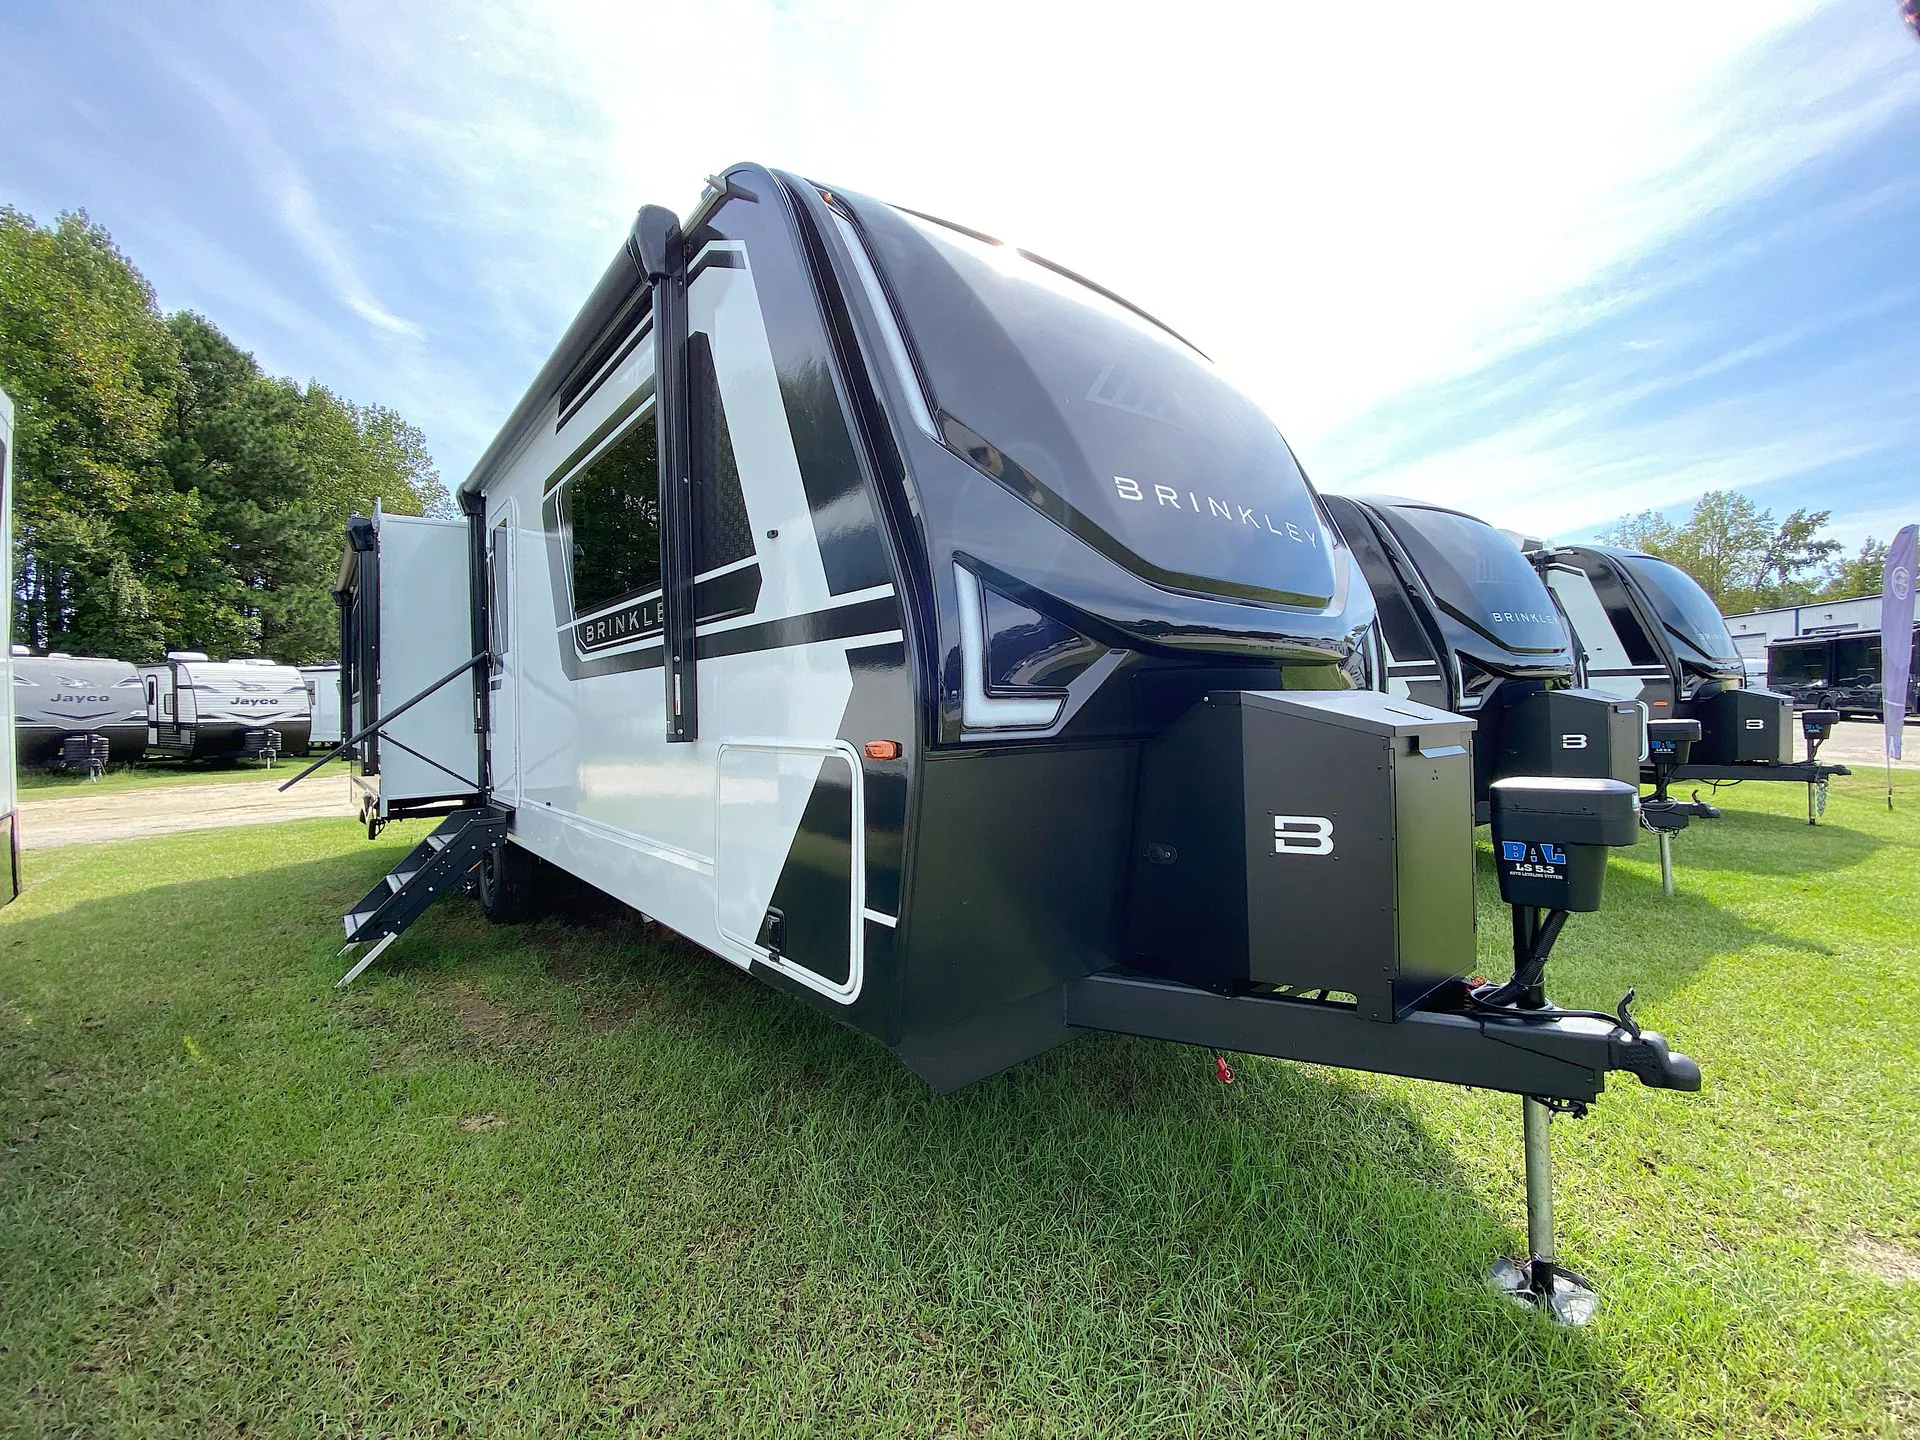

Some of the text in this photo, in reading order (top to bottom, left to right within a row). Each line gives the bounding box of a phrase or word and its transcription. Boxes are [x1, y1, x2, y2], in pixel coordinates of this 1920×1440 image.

[1113, 475, 1317, 548] BRINKLEY
[586, 602, 663, 642] BRINKLE
[51, 693, 110, 703] Jayco
[230, 696, 279, 706] Jayco
[1275, 815, 1334, 855] B
[1516, 863, 1555, 873] LS 5.3
